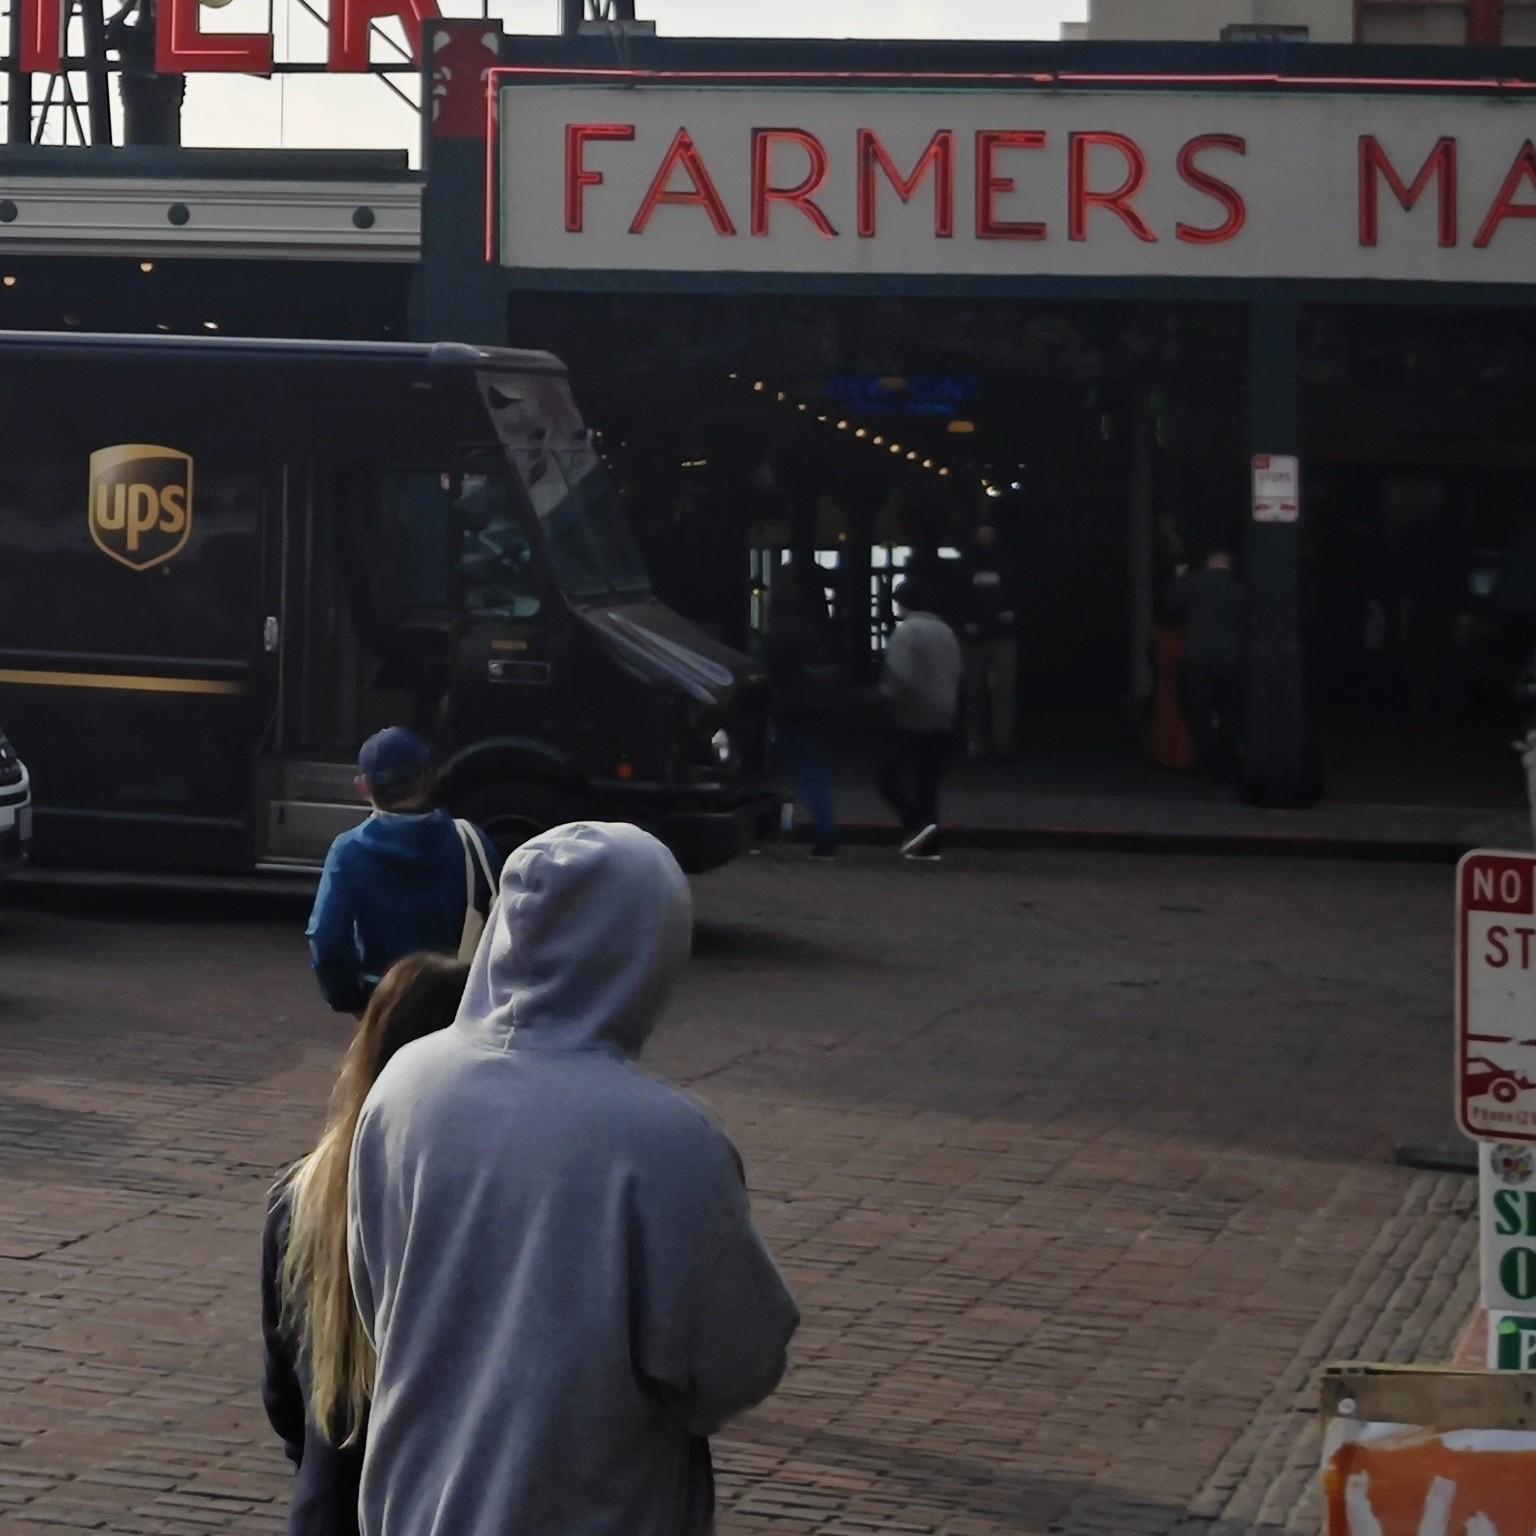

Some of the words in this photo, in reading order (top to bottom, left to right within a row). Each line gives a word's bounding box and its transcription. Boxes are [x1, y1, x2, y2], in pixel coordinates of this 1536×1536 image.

[563, 123, 1247, 245] FARMERS
[1357, 134, 1536, 249] MA
[97, 483, 185, 551] ups
[1472, 867, 1522, 905] NO
[1485, 925, 1536, 970] ST
